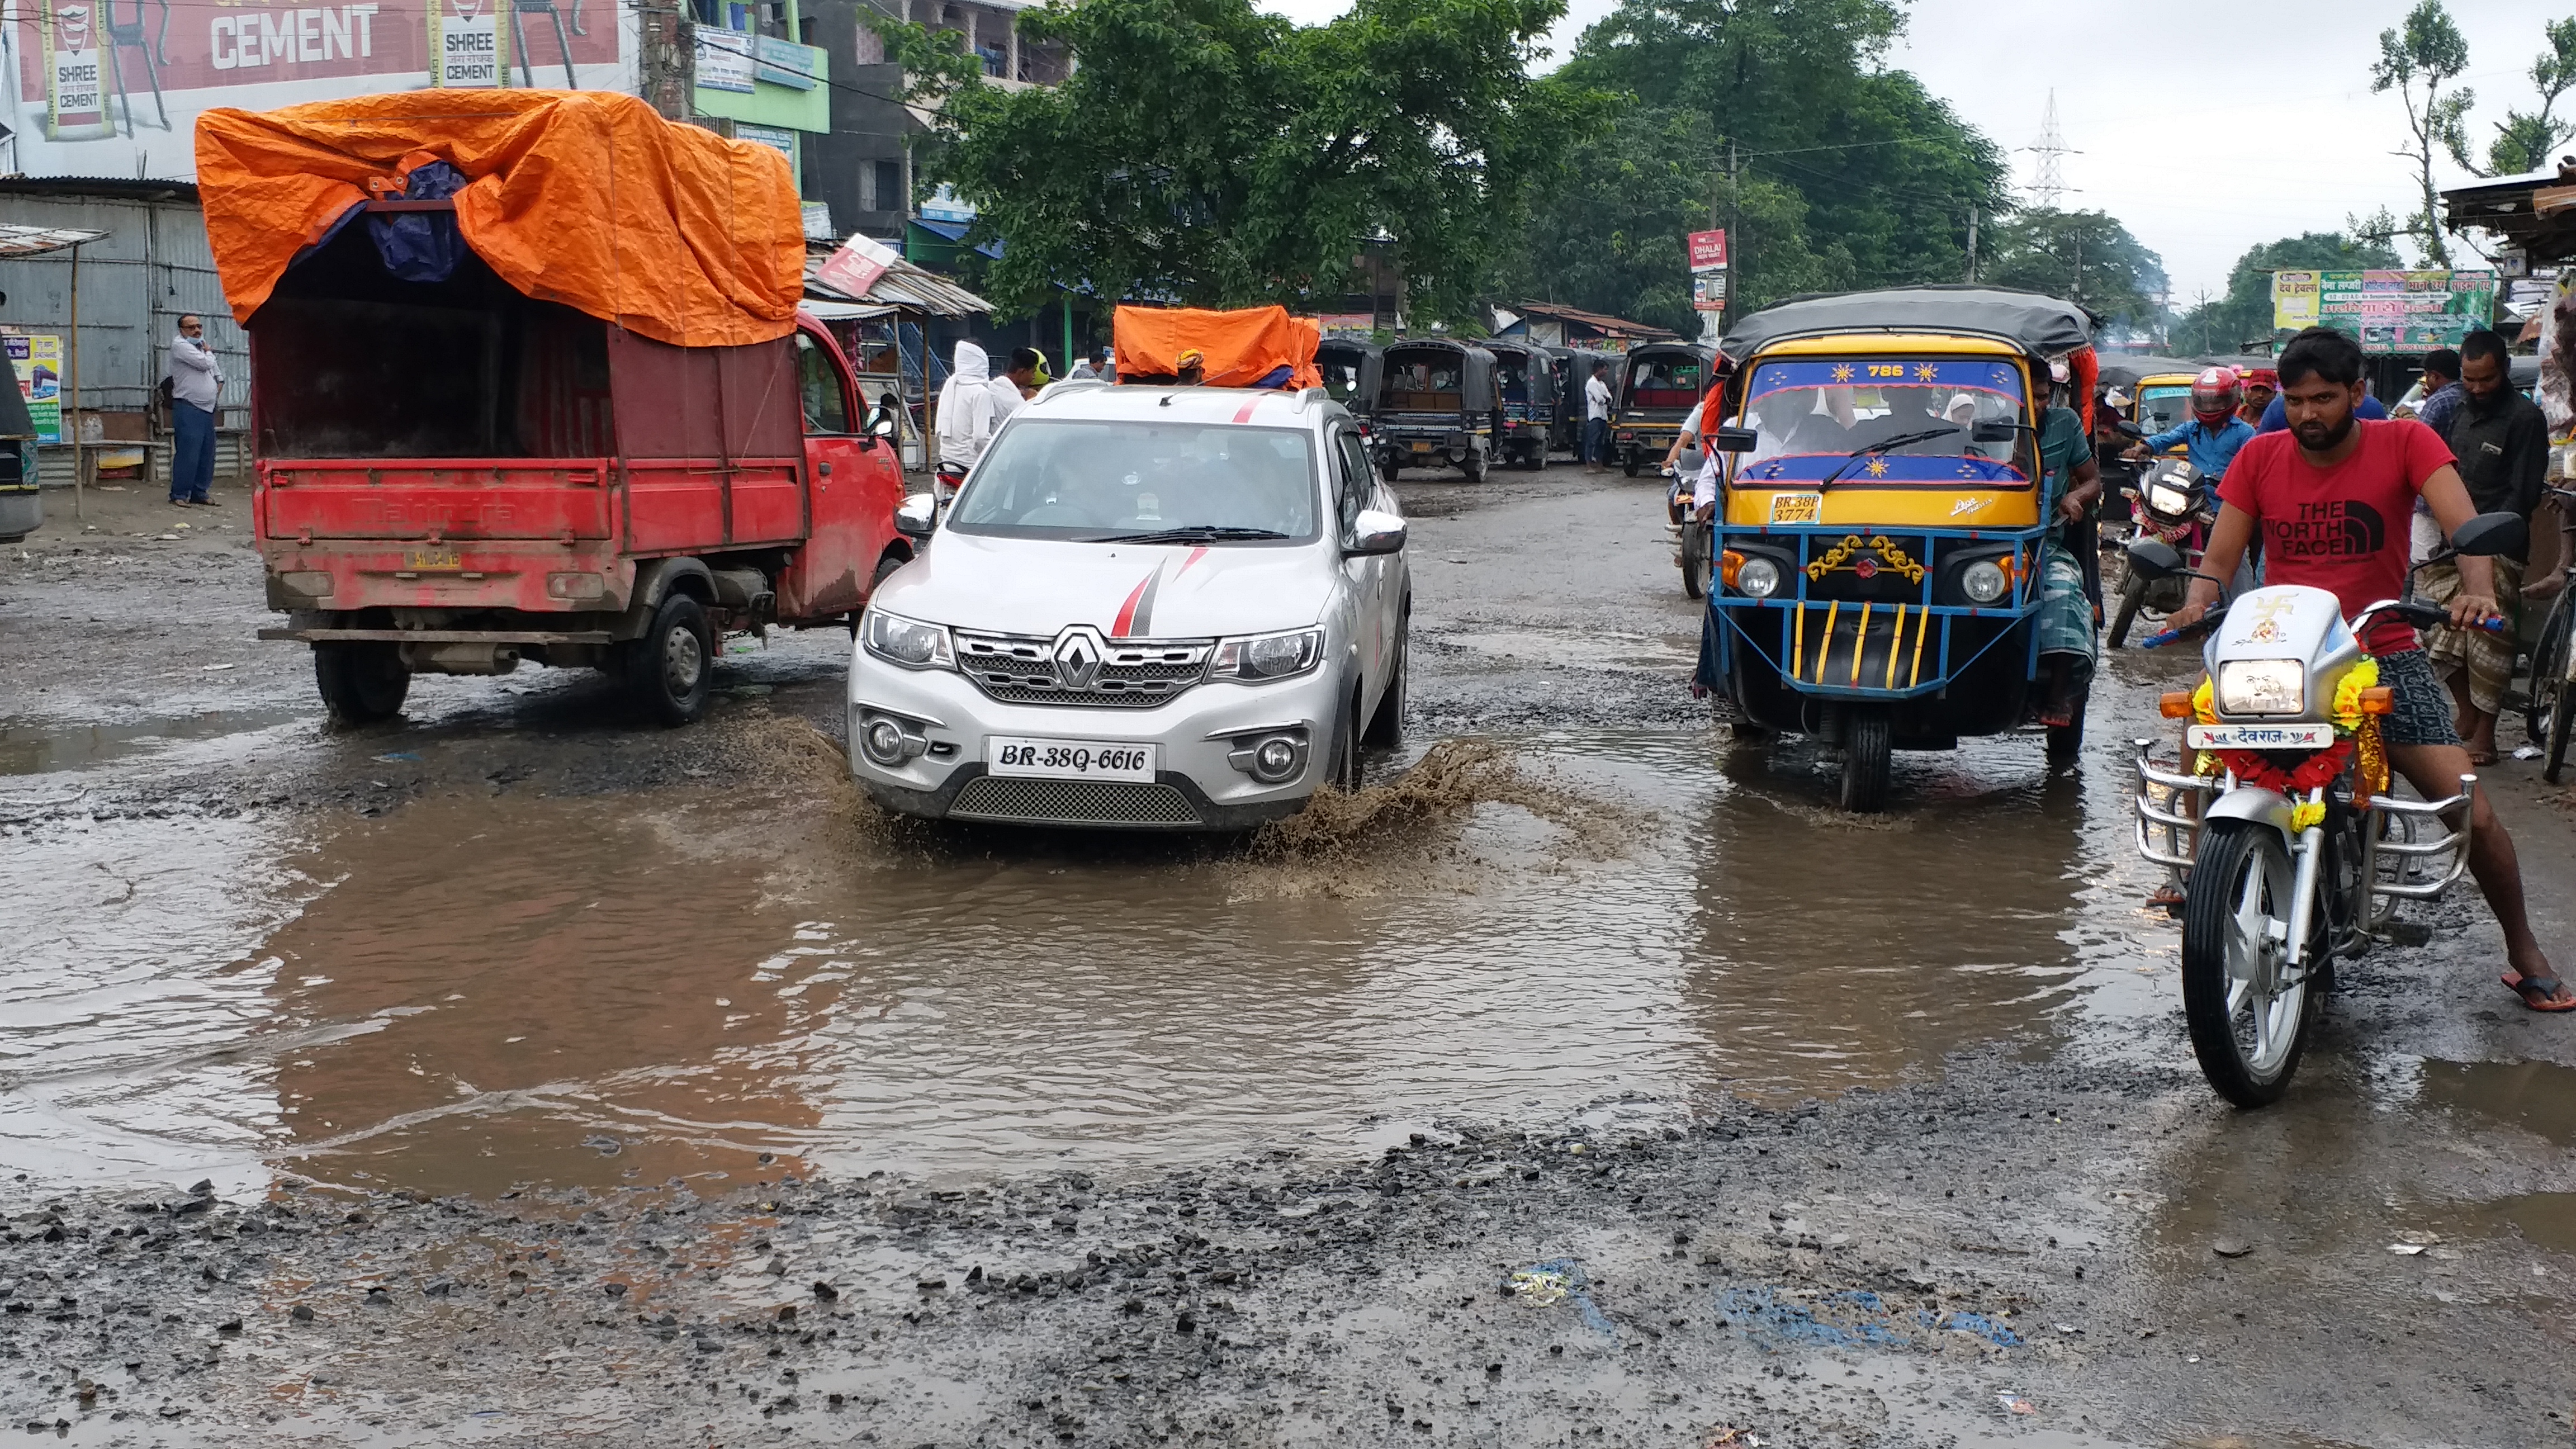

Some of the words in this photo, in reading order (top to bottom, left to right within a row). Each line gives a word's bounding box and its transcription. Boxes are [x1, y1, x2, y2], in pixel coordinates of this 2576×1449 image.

[211, 2, 380, 70] CEMENT
[447, 33, 494, 51] SHREE
[59, 64, 97, 83] SHREE
[447, 64, 494, 79] CEMENT
[60, 93, 98, 107] CEMENT
[1694, 244, 1722, 255] DHALAI
[1868, 365, 1903, 377] 786
[1774, 508, 1815, 522] 3774
[2298, 501, 2343, 520] THE
[2266, 519, 2342, 539] NORTH
[2282, 538, 2343, 556] FACE
[2238, 727, 2283, 743] देवराज
